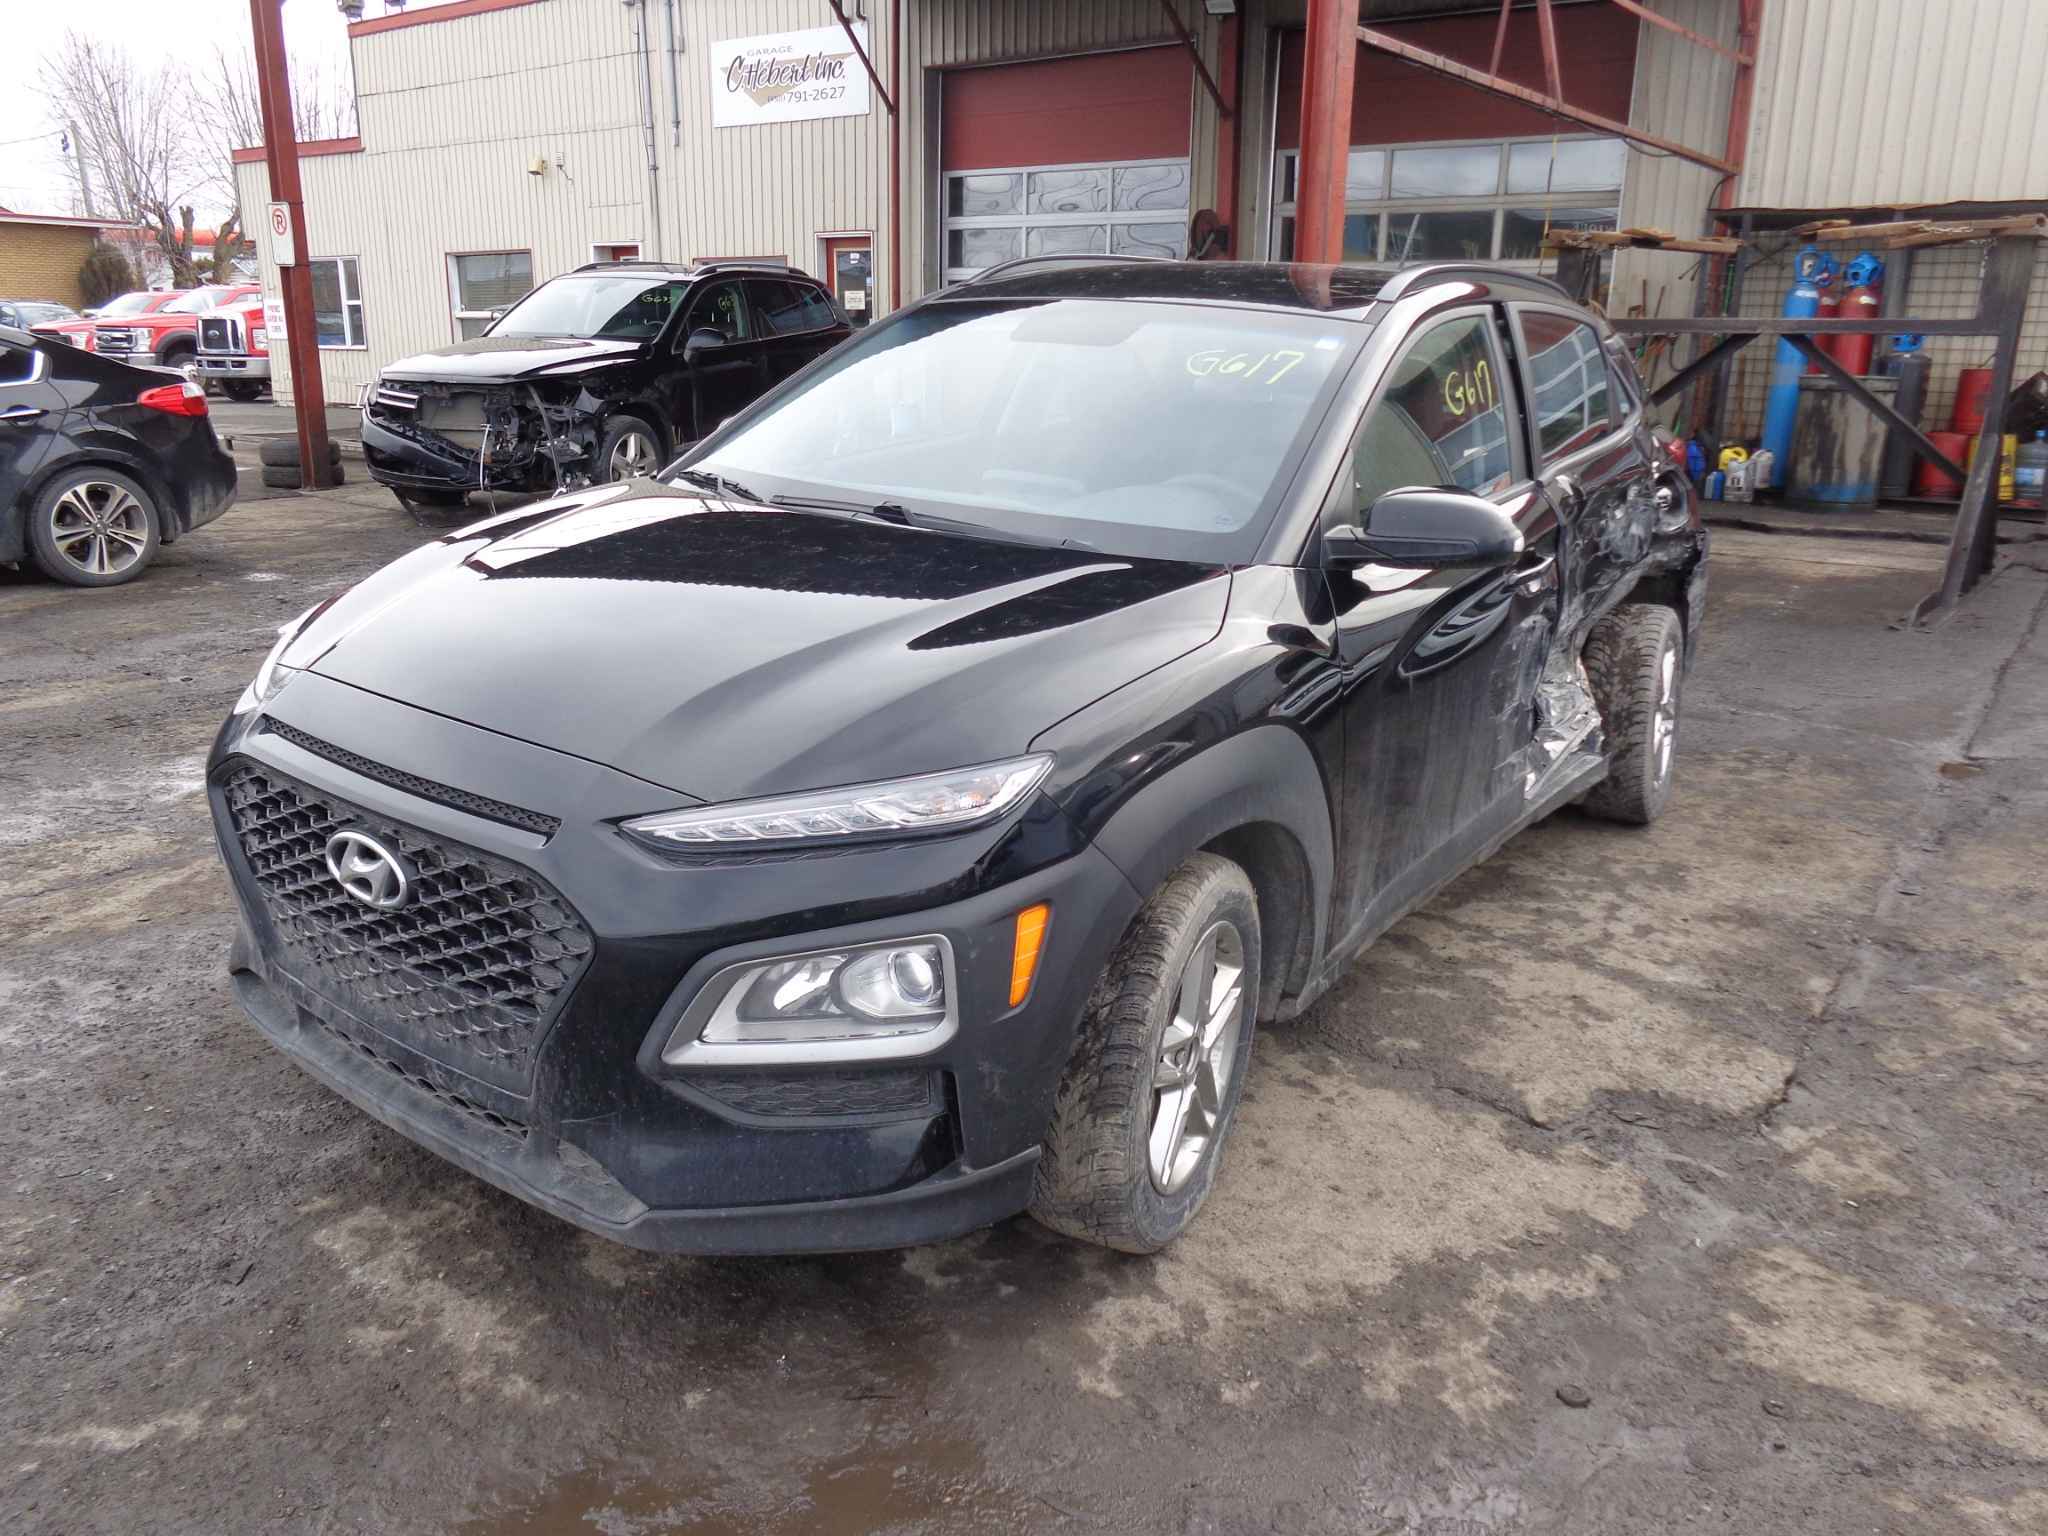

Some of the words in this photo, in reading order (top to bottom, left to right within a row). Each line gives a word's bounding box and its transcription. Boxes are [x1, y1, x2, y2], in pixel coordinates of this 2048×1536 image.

[746, 45, 793, 57] GARAGE
[787, 86, 846, 104] 791-2627
[1186, 349, 1305, 385] G617
[1445, 359, 1493, 416] G617
